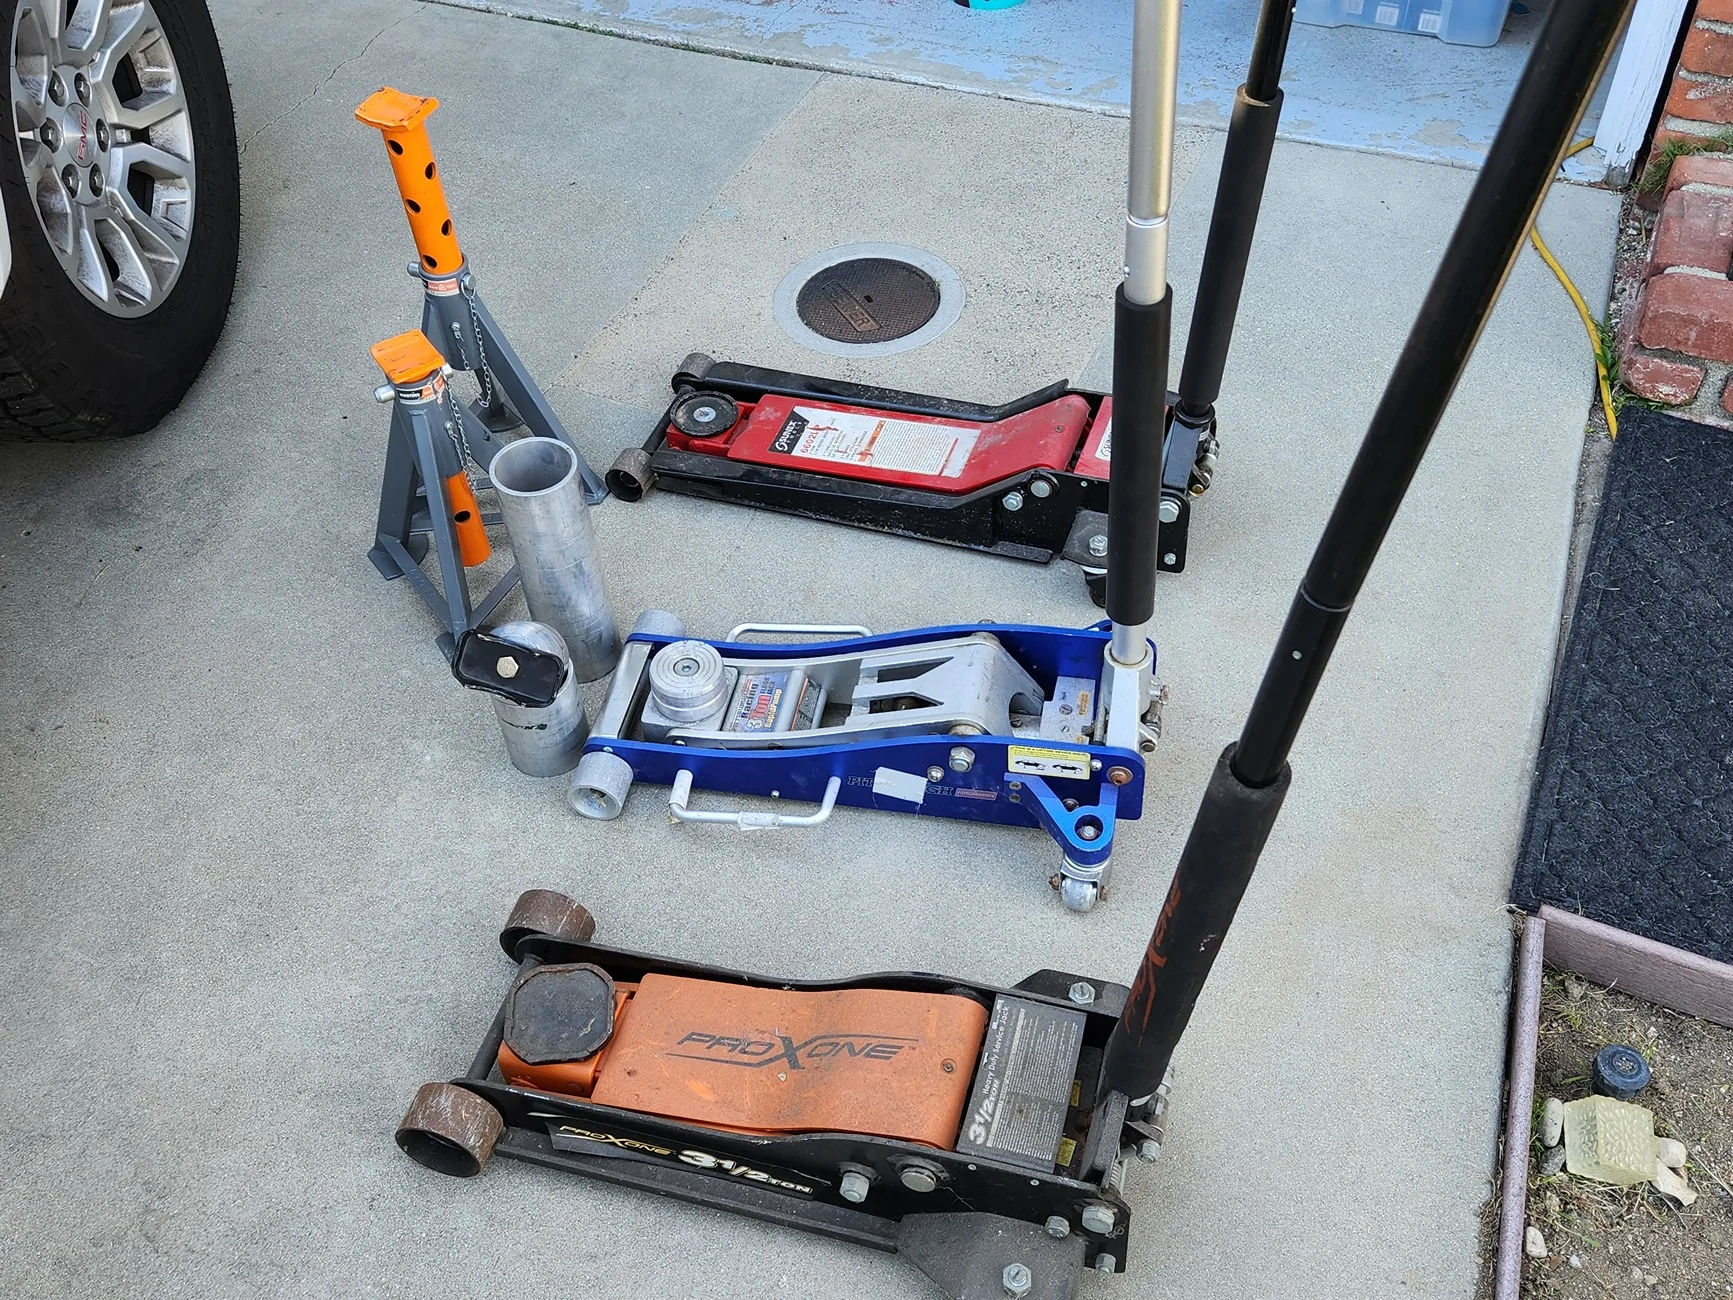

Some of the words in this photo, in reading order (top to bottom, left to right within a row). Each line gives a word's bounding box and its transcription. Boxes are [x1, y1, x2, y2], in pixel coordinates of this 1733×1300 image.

[77, 109, 87, 160] GMC
[779, 419, 797, 442] SUNEX
[741, 683, 758, 718] Racing
[749, 695, 771, 719] Ton
[746, 718, 763, 729] 3
[1000, 1005, 1010, 1025] Jack
[677, 1031, 905, 1070] PROXONE
[994, 1025, 1005, 1054] Service
[988, 1050, 1000, 1071] Duty
[982, 1071, 996, 1095] Heavy
[559, 1125, 672, 1156] PROXONE
